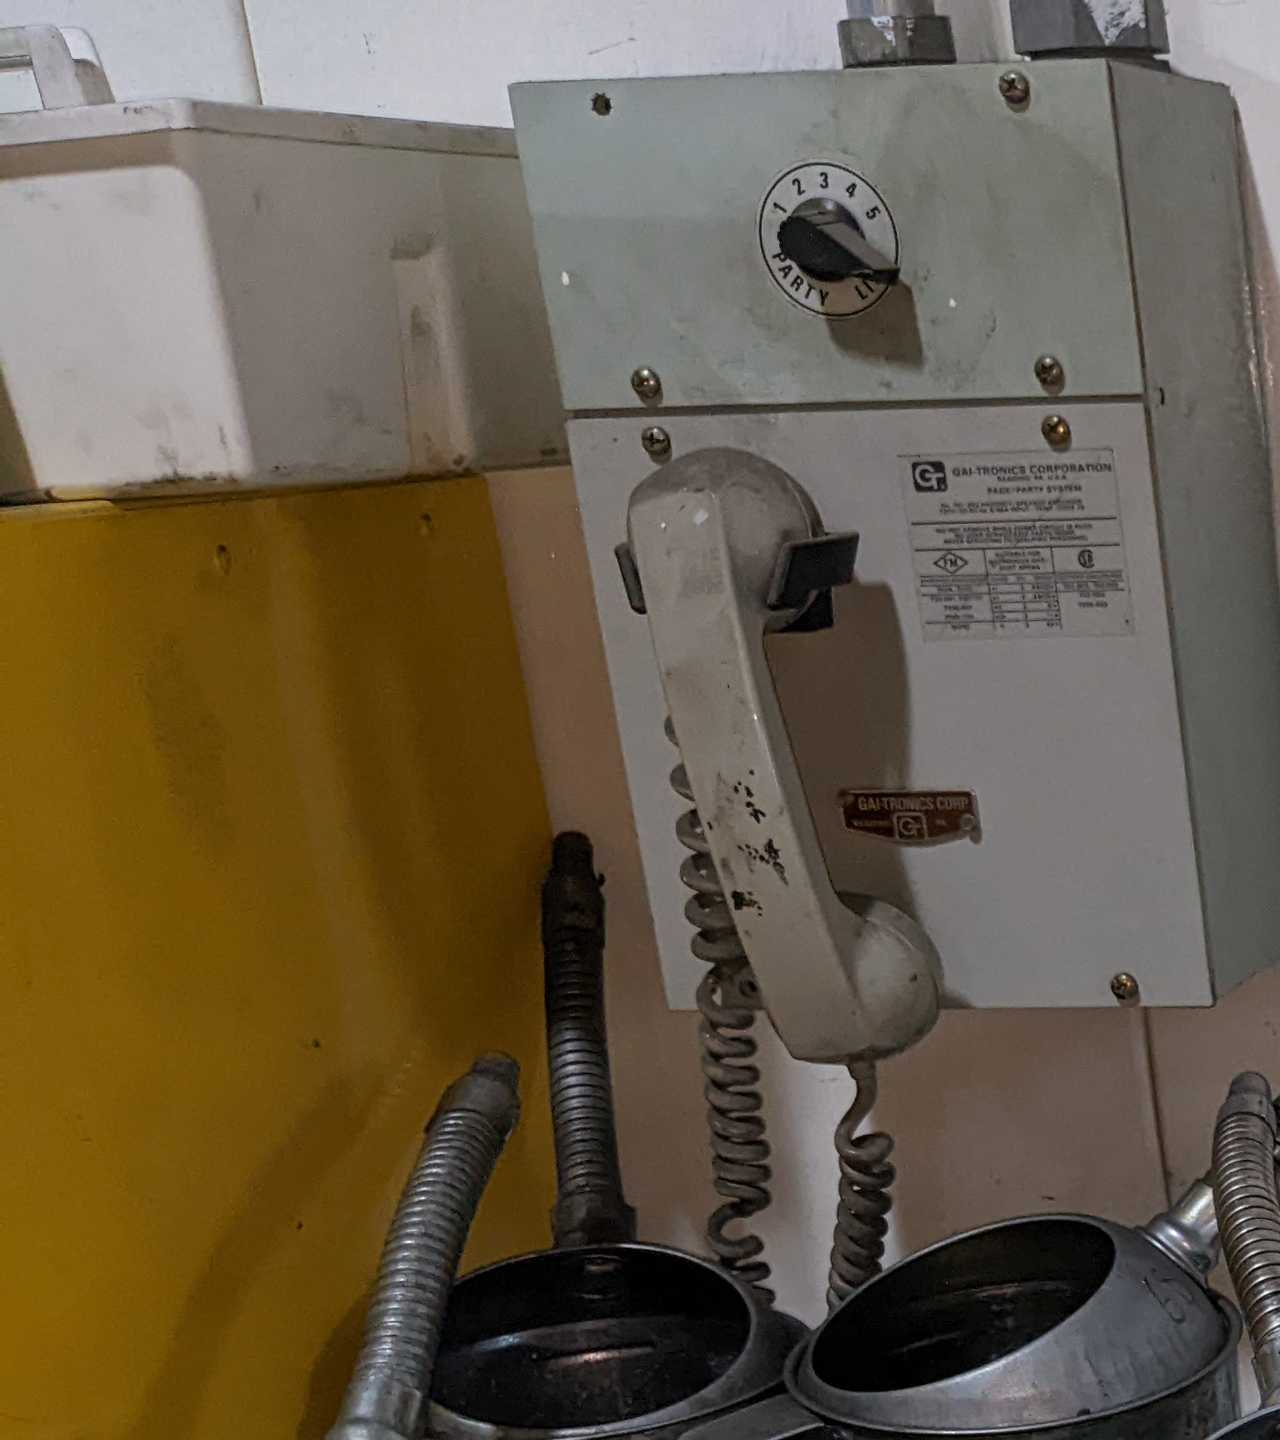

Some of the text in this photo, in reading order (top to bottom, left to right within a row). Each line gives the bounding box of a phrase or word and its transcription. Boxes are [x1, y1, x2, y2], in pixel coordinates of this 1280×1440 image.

[819, 172, 829, 189] 3
[772, 251, 829, 306] PARTY
[1029, 463, 1112, 475] CORPORATION
